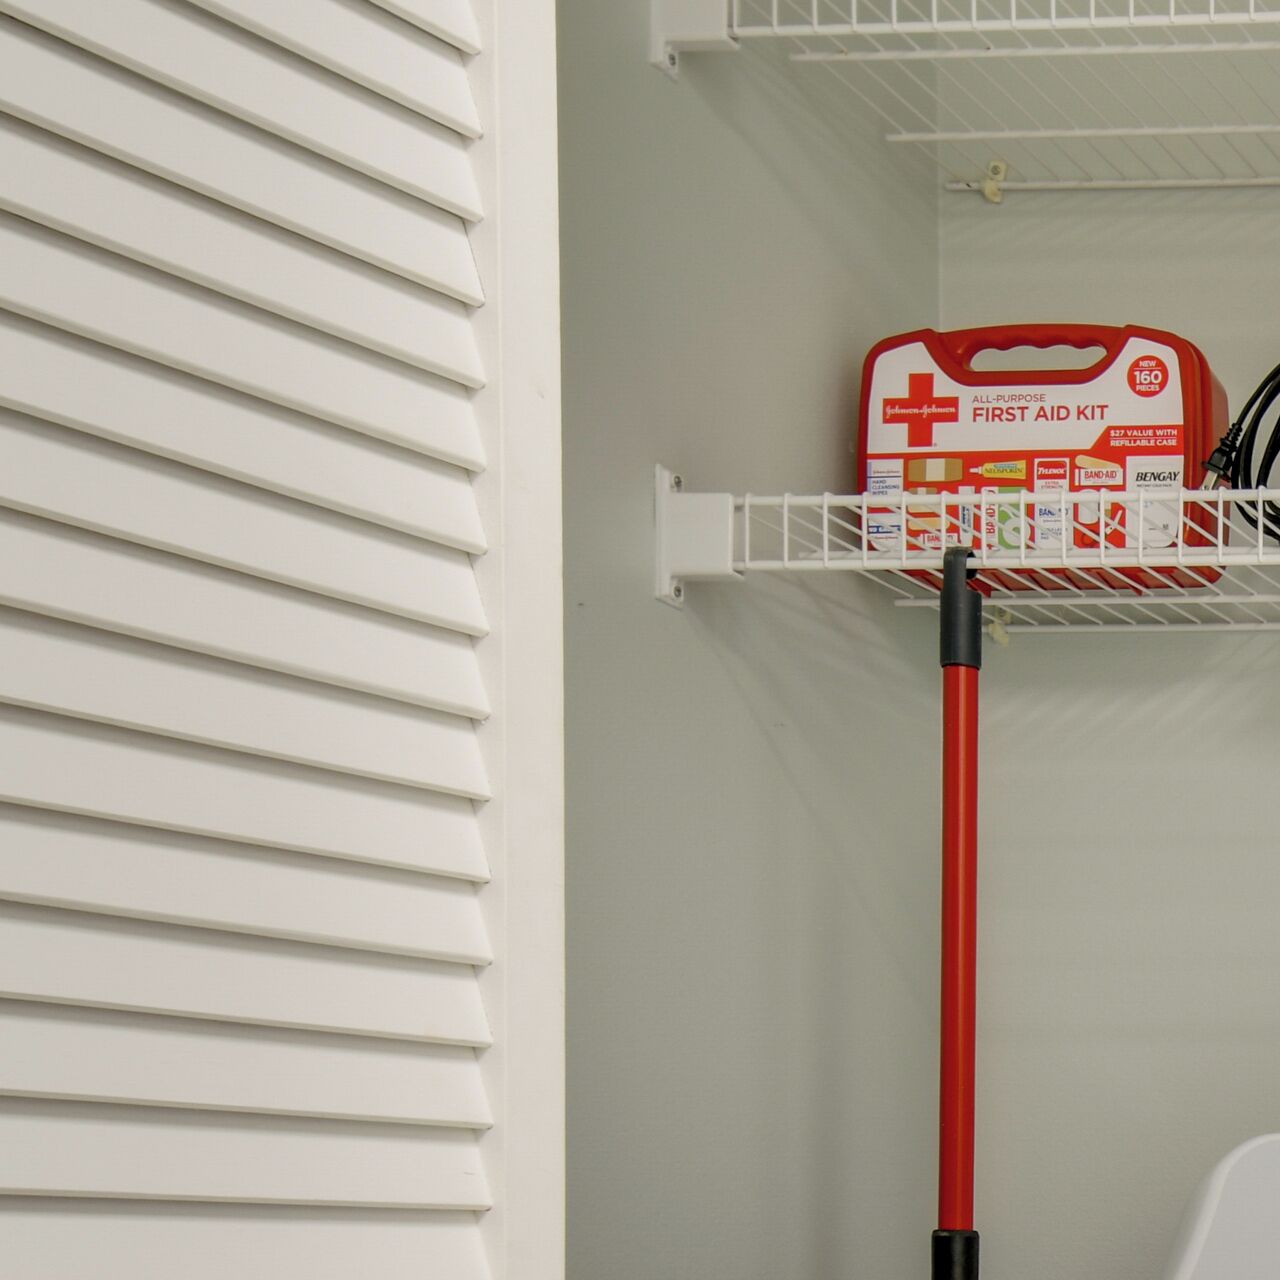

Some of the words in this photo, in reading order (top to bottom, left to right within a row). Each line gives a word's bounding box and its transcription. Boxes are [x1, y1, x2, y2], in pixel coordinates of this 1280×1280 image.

[1133, 370, 1162, 384] 160
[1136, 384, 1160, 392] PIECES
[971, 393, 1047, 404] ALL-PURPOSE
[972, 405, 1029, 423] FIRST
[1033, 404, 1071, 422] AID
[1076, 404, 1109, 421] KIT
[1109, 429, 1124, 438] $27
[1126, 429, 1154, 437] VALUE
[1156, 428, 1178, 437] WITH
[1110, 438, 1155, 447] REFILLABLE
[1157, 438, 1177, 446] CASE
[1084, 470, 1118, 480] BAND-AID
[1135, 471, 1180, 482] BENGAY
